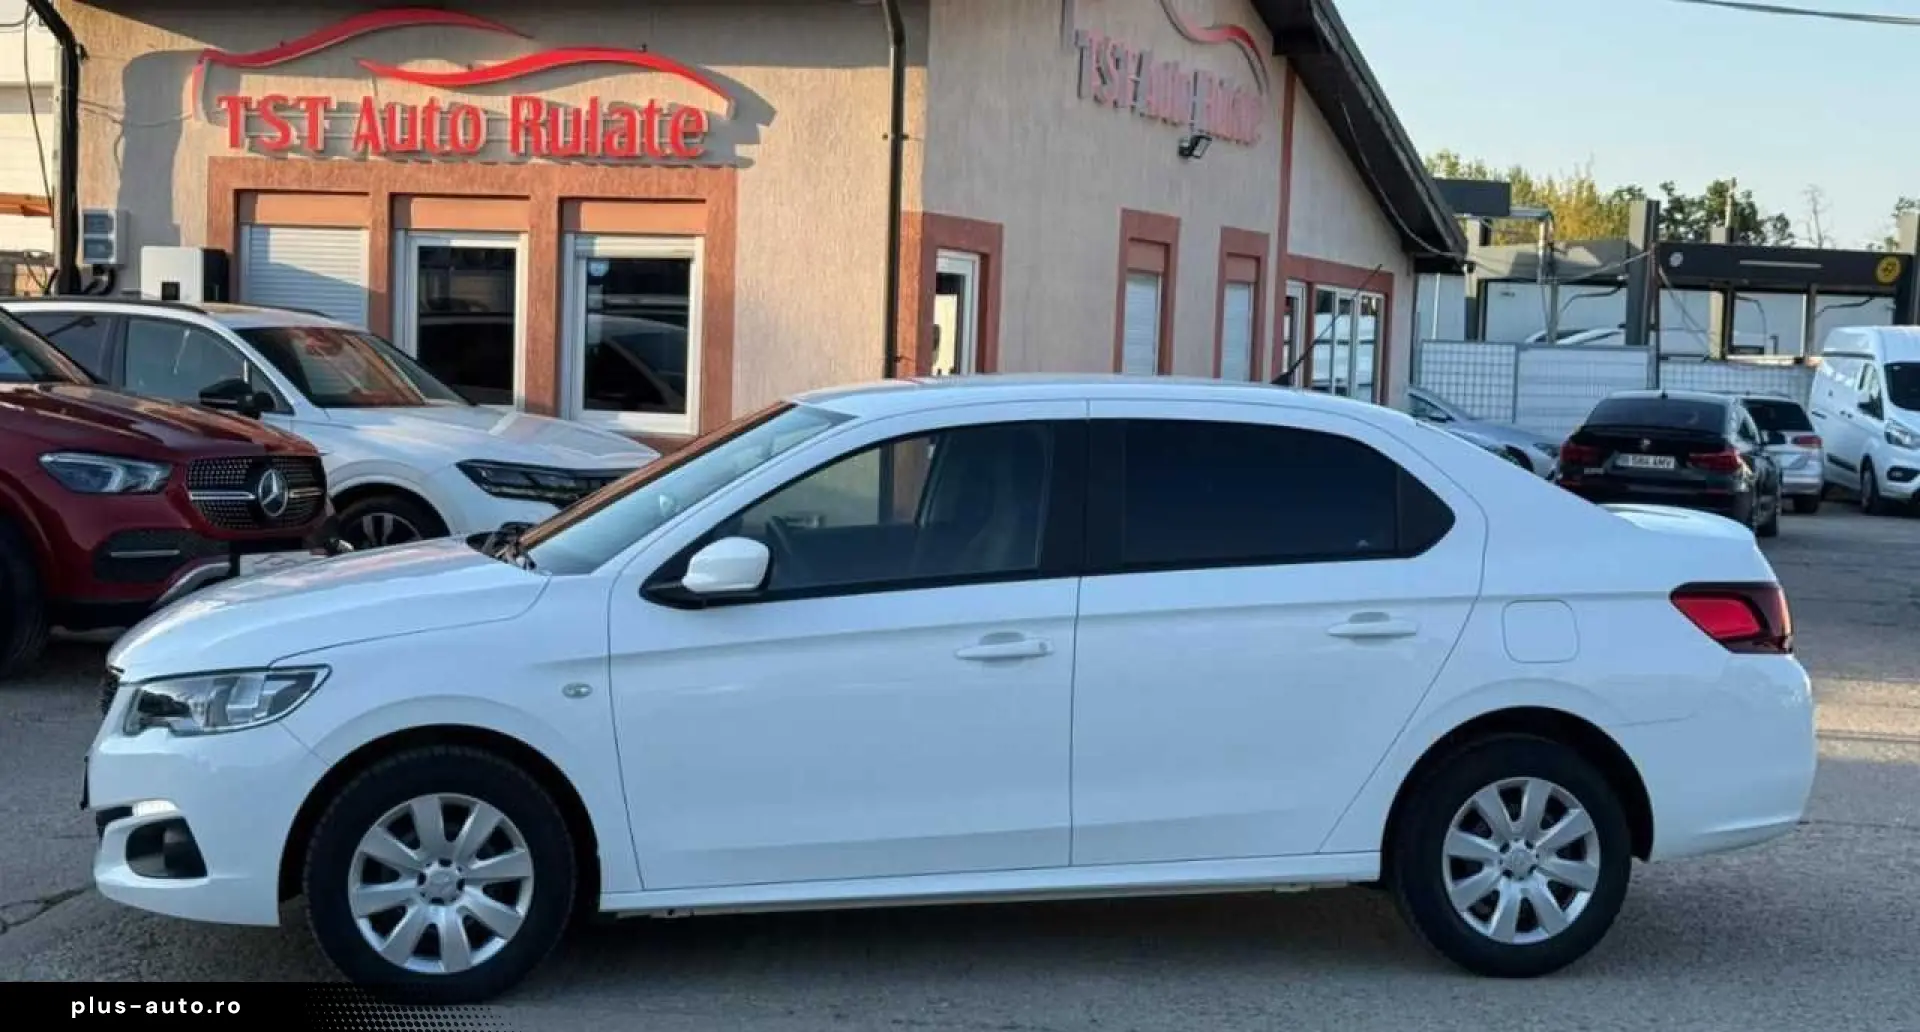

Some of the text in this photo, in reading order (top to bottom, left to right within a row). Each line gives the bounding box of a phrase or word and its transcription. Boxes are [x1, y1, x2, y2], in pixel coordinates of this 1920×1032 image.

[216, 94, 708, 158] TST Auto Rulate
